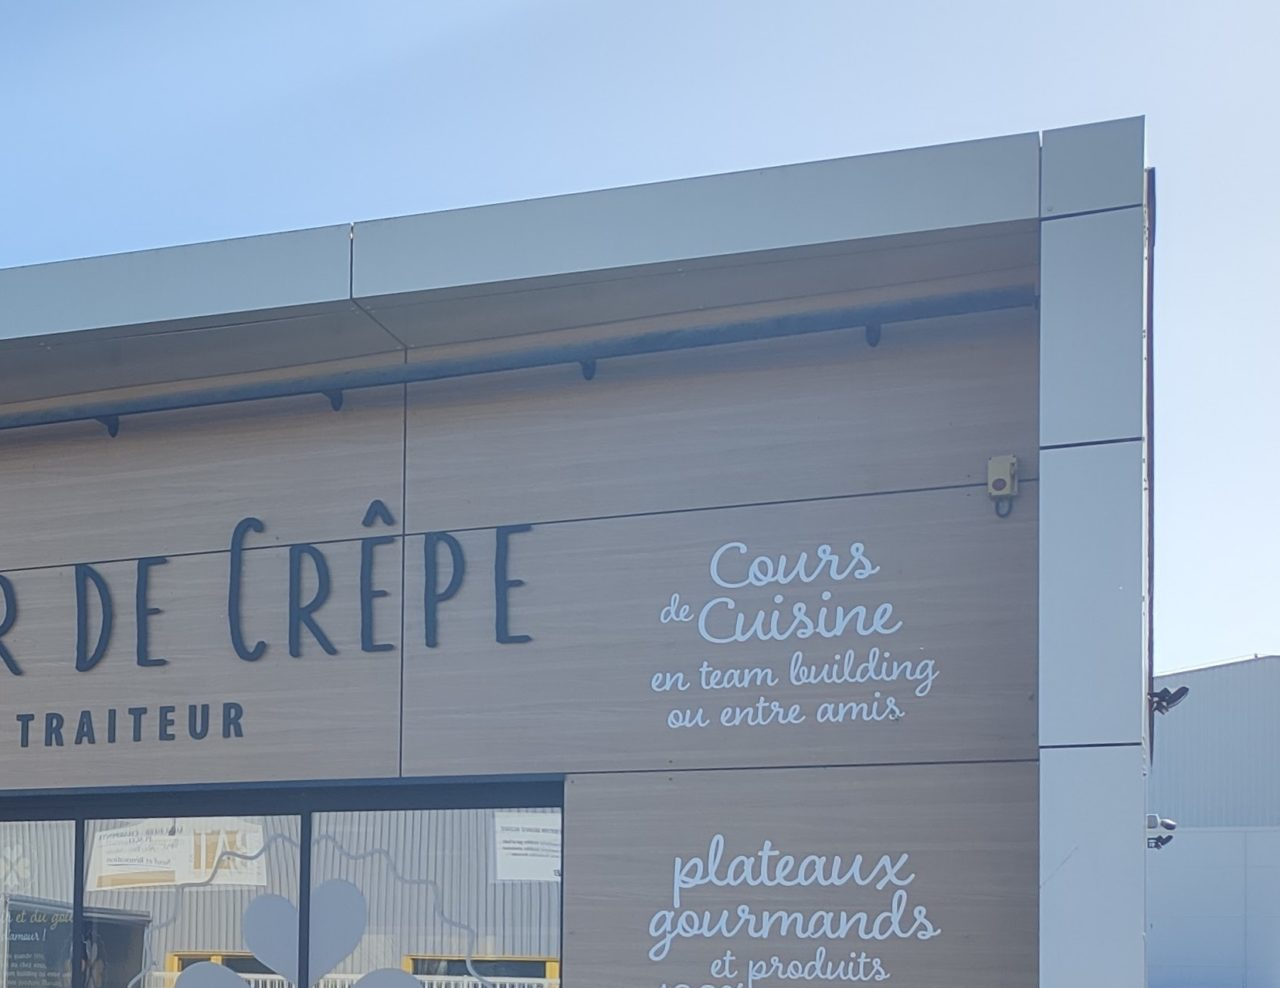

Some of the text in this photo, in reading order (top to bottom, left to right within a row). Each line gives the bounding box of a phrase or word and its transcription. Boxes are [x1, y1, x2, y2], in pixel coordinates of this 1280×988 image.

[74, 555, 168, 672] DE
[227, 499, 533, 662] CRÊPE
[710, 542, 880, 588] Cours
[660, 591, 903, 644] de Cuisine
[650, 647, 940, 697] en team building
[16, 702, 244, 748] TRAITEUR
[667, 691, 905, 729] ou entre amis
[673, 833, 916, 908] plateaux
[648, 889, 941, 961] gourmands
[710, 950, 738, 978] et
